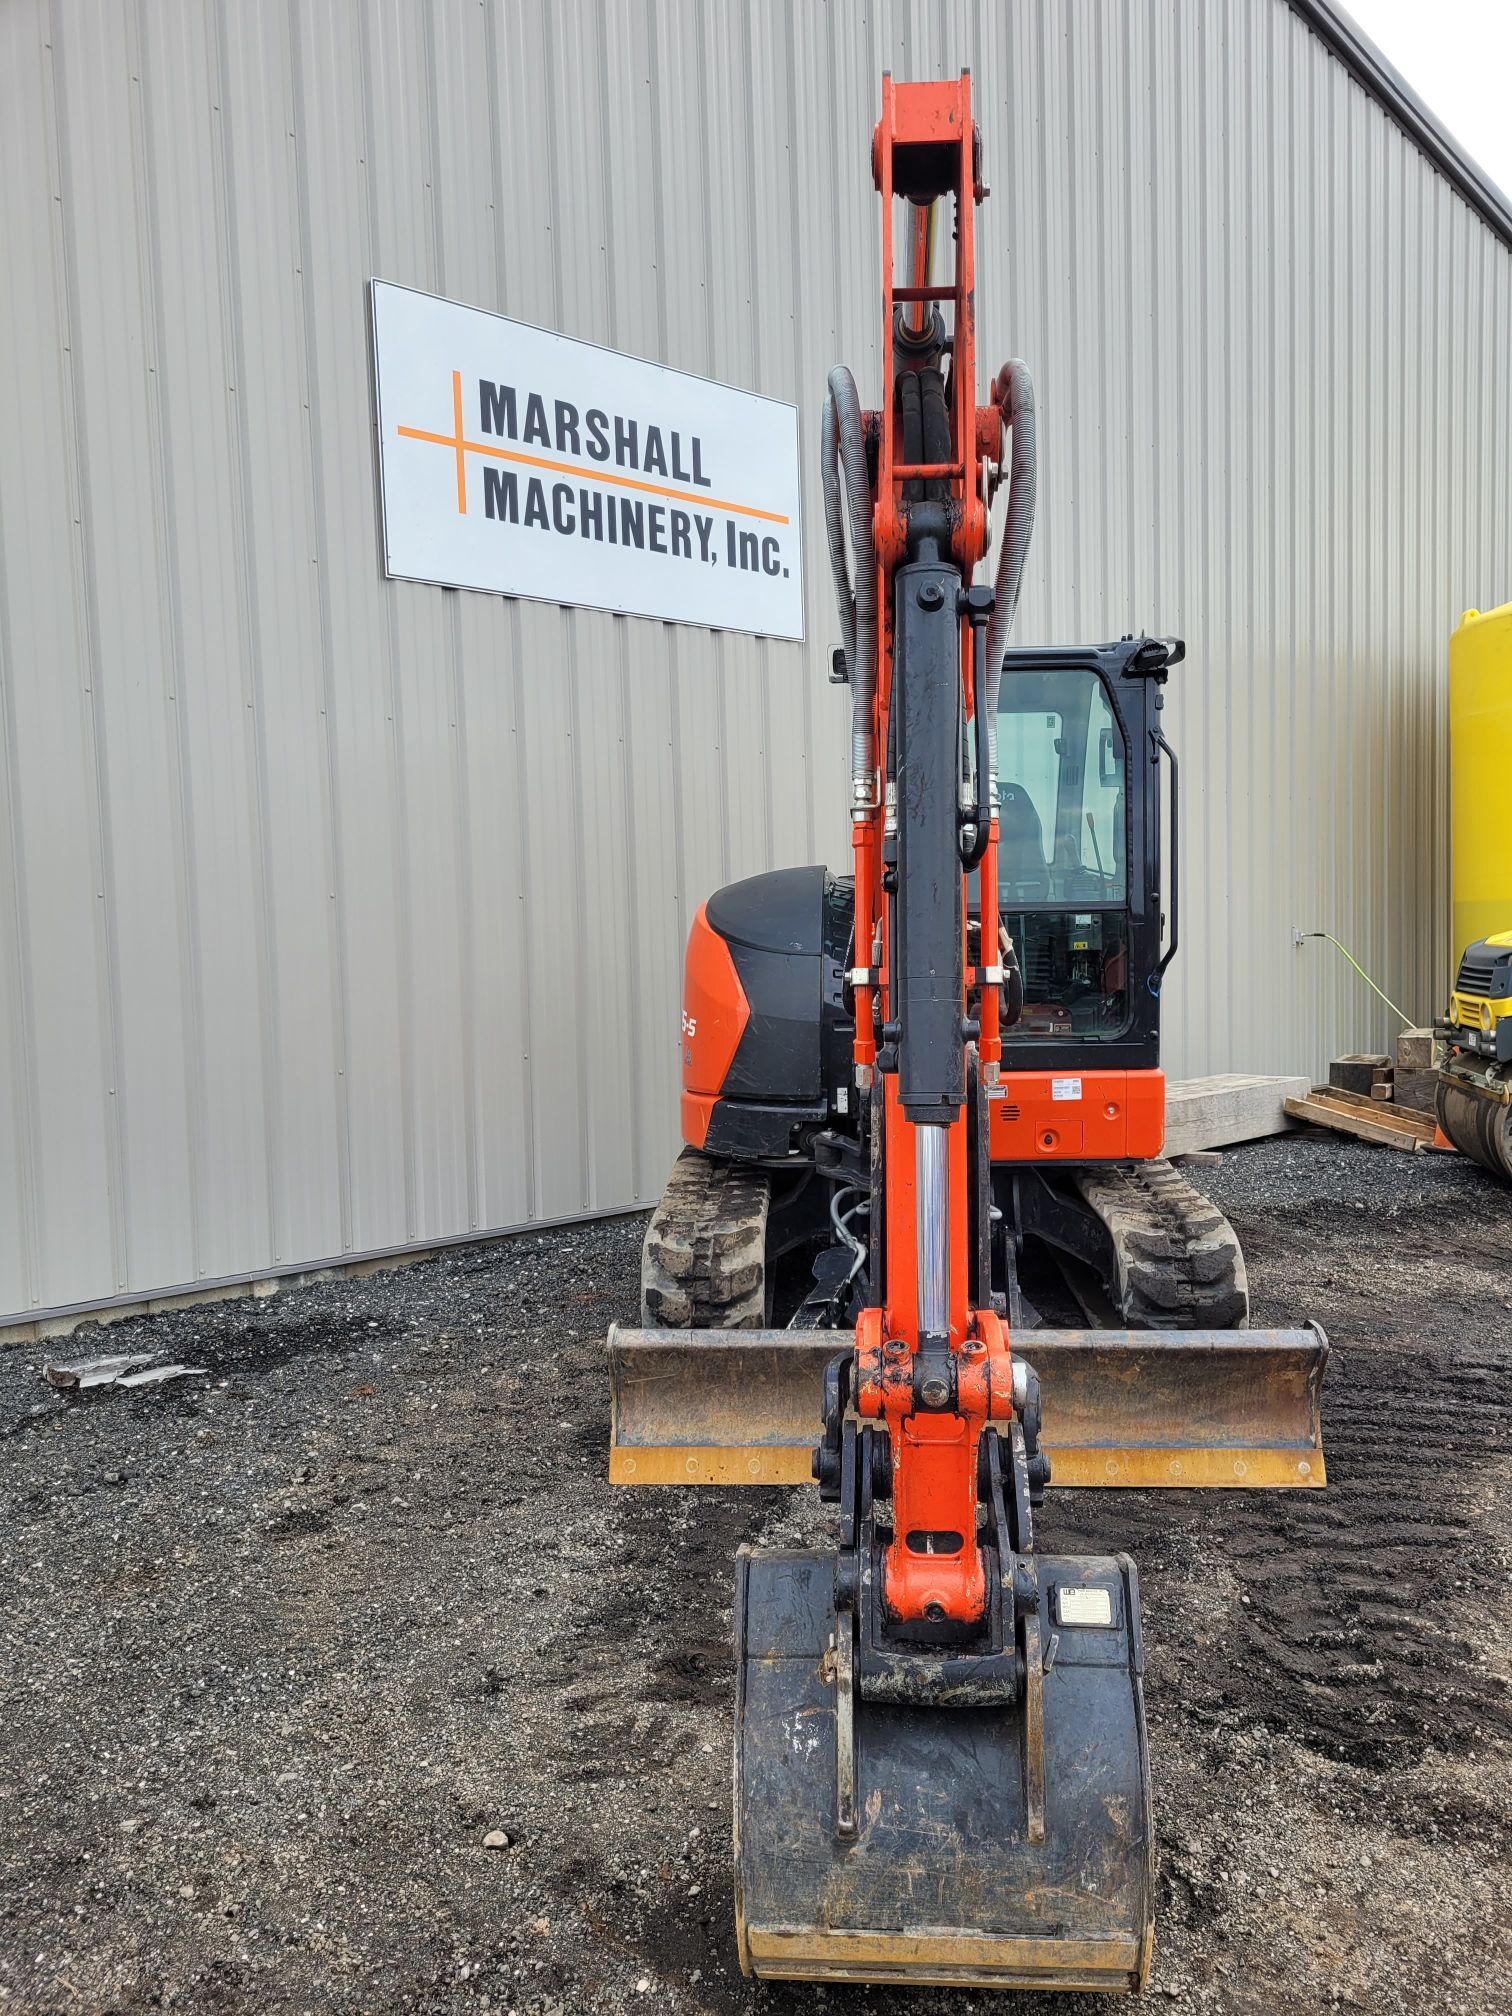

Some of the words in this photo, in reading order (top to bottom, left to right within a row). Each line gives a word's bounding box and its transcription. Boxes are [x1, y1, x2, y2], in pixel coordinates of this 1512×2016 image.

[479, 379, 711, 487] MARSHALL
[483, 467, 717, 567] MACHINERY,
[727, 520, 789, 578] Inc.
